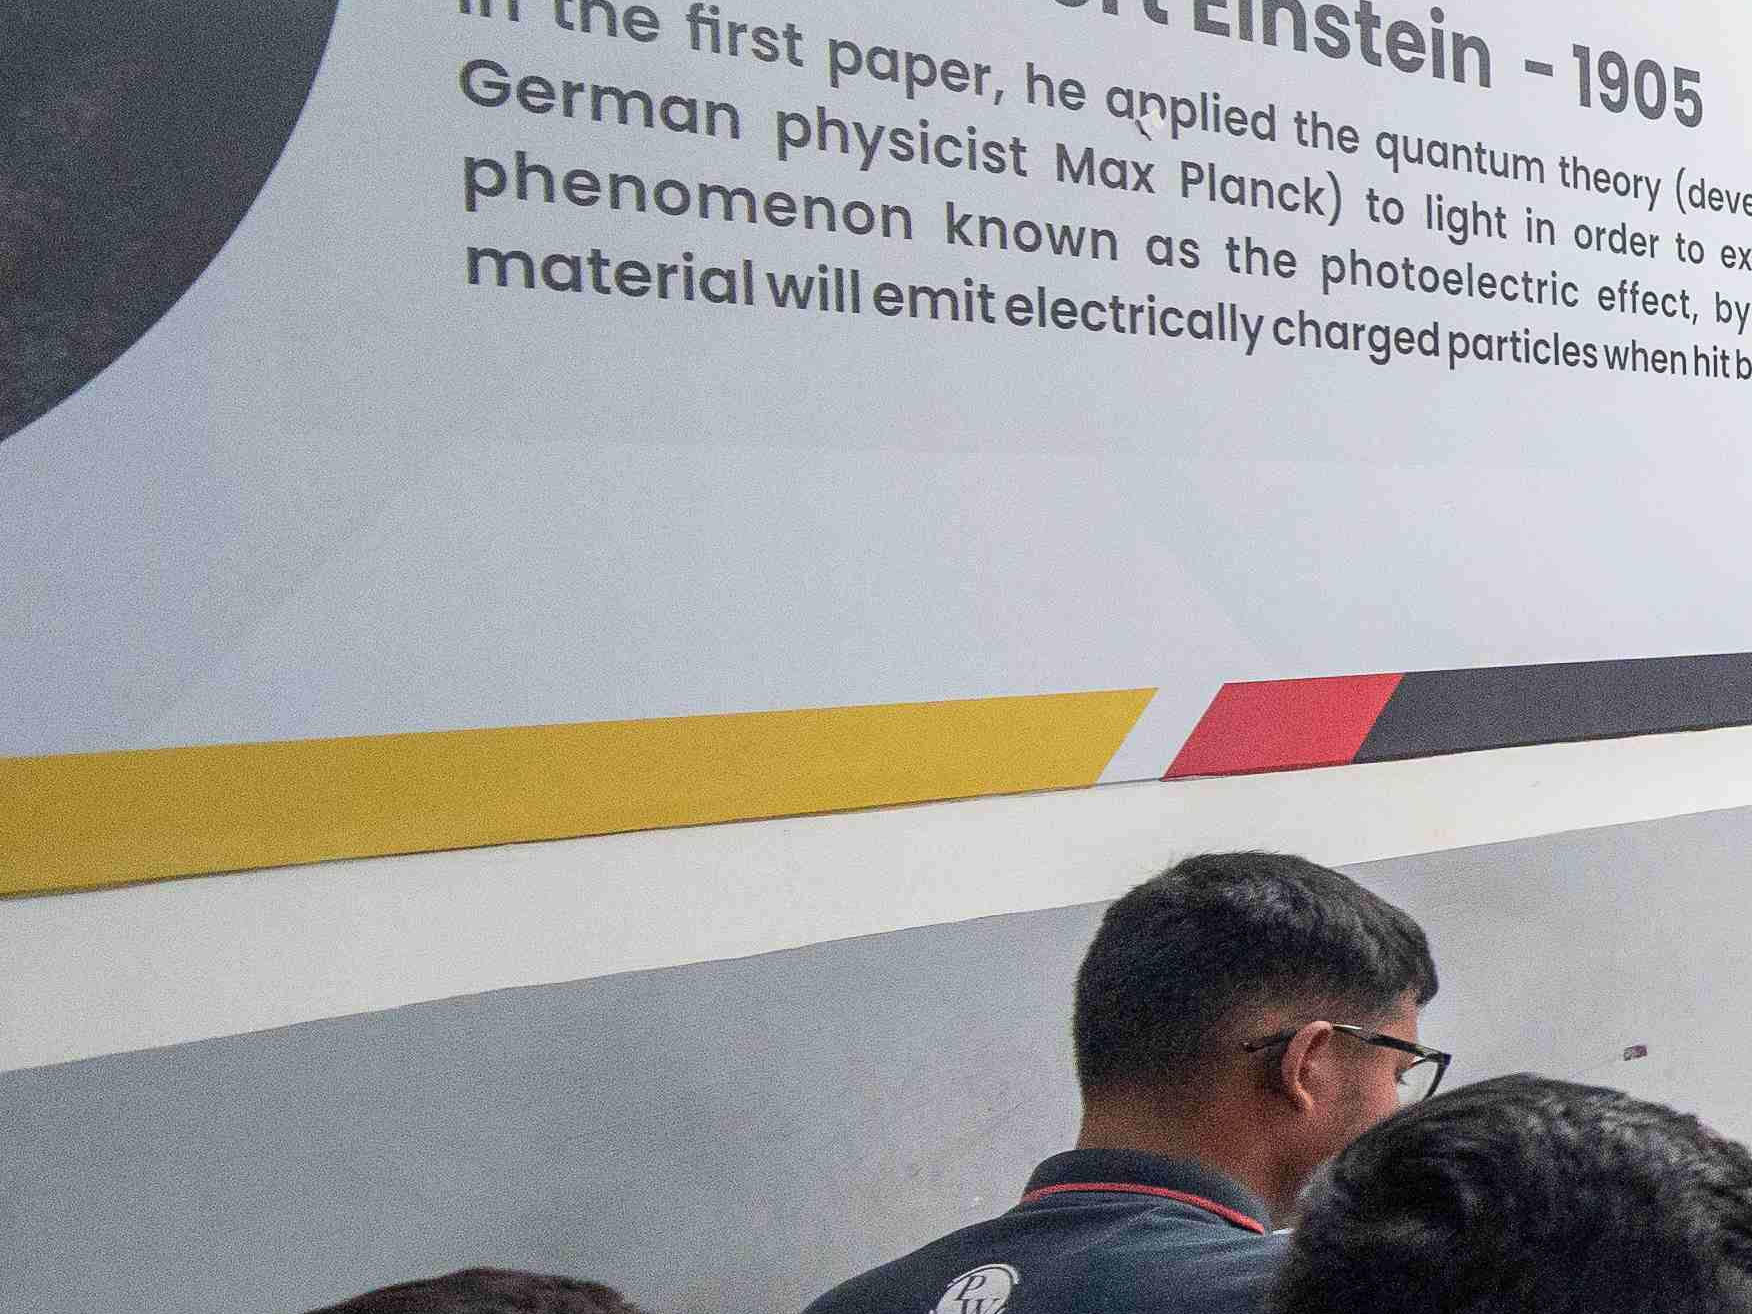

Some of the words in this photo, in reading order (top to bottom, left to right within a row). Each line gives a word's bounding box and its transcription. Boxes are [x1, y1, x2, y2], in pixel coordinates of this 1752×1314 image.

[460, 59, 740, 139] German
[777, 106, 1027, 177] physicist
[1056, 143, 1155, 193] Max
[1181, 161, 1341, 226] Planck)
[1366, 188, 1404, 225] to
[1426, 194, 1507, 245] light
[1527, 217, 1555, 245] in
[1574, 222, 1659, 258] order
[1675, 233, 1704, 264] to
[686, 3, 803, 67] first
[829, 39, 1003, 105] paper,
[1026, 62, 1086, 111] he
[1106, 86, 1276, 142] applied
[1294, 111, 1359, 154] the
[1376, 132, 1544, 183] quantum
[1559, 156, 1661, 211] theory
[1573, 44, 1703, 128] 1905
[464, 150, 912, 239] phenomenon
[946, 201, 1117, 260] known
[1146, 235, 1200, 269] as
[1225, 236, 1296, 278] the
[1322, 249, 1578, 307] photoelectric
[1598, 279, 1700, 326] effect,
[1716, 292, 1750, 335] by
[467, 247, 754, 305] material
[766, 264, 861, 314] will
[872, 277, 996, 325] emit
[1005, 286, 1264, 356] electrically
[1273, 309, 1440, 365] charged
[1448, 327, 1599, 369] particles
[1604, 339, 1688, 376] when
[1694, 345, 1731, 378] hit
